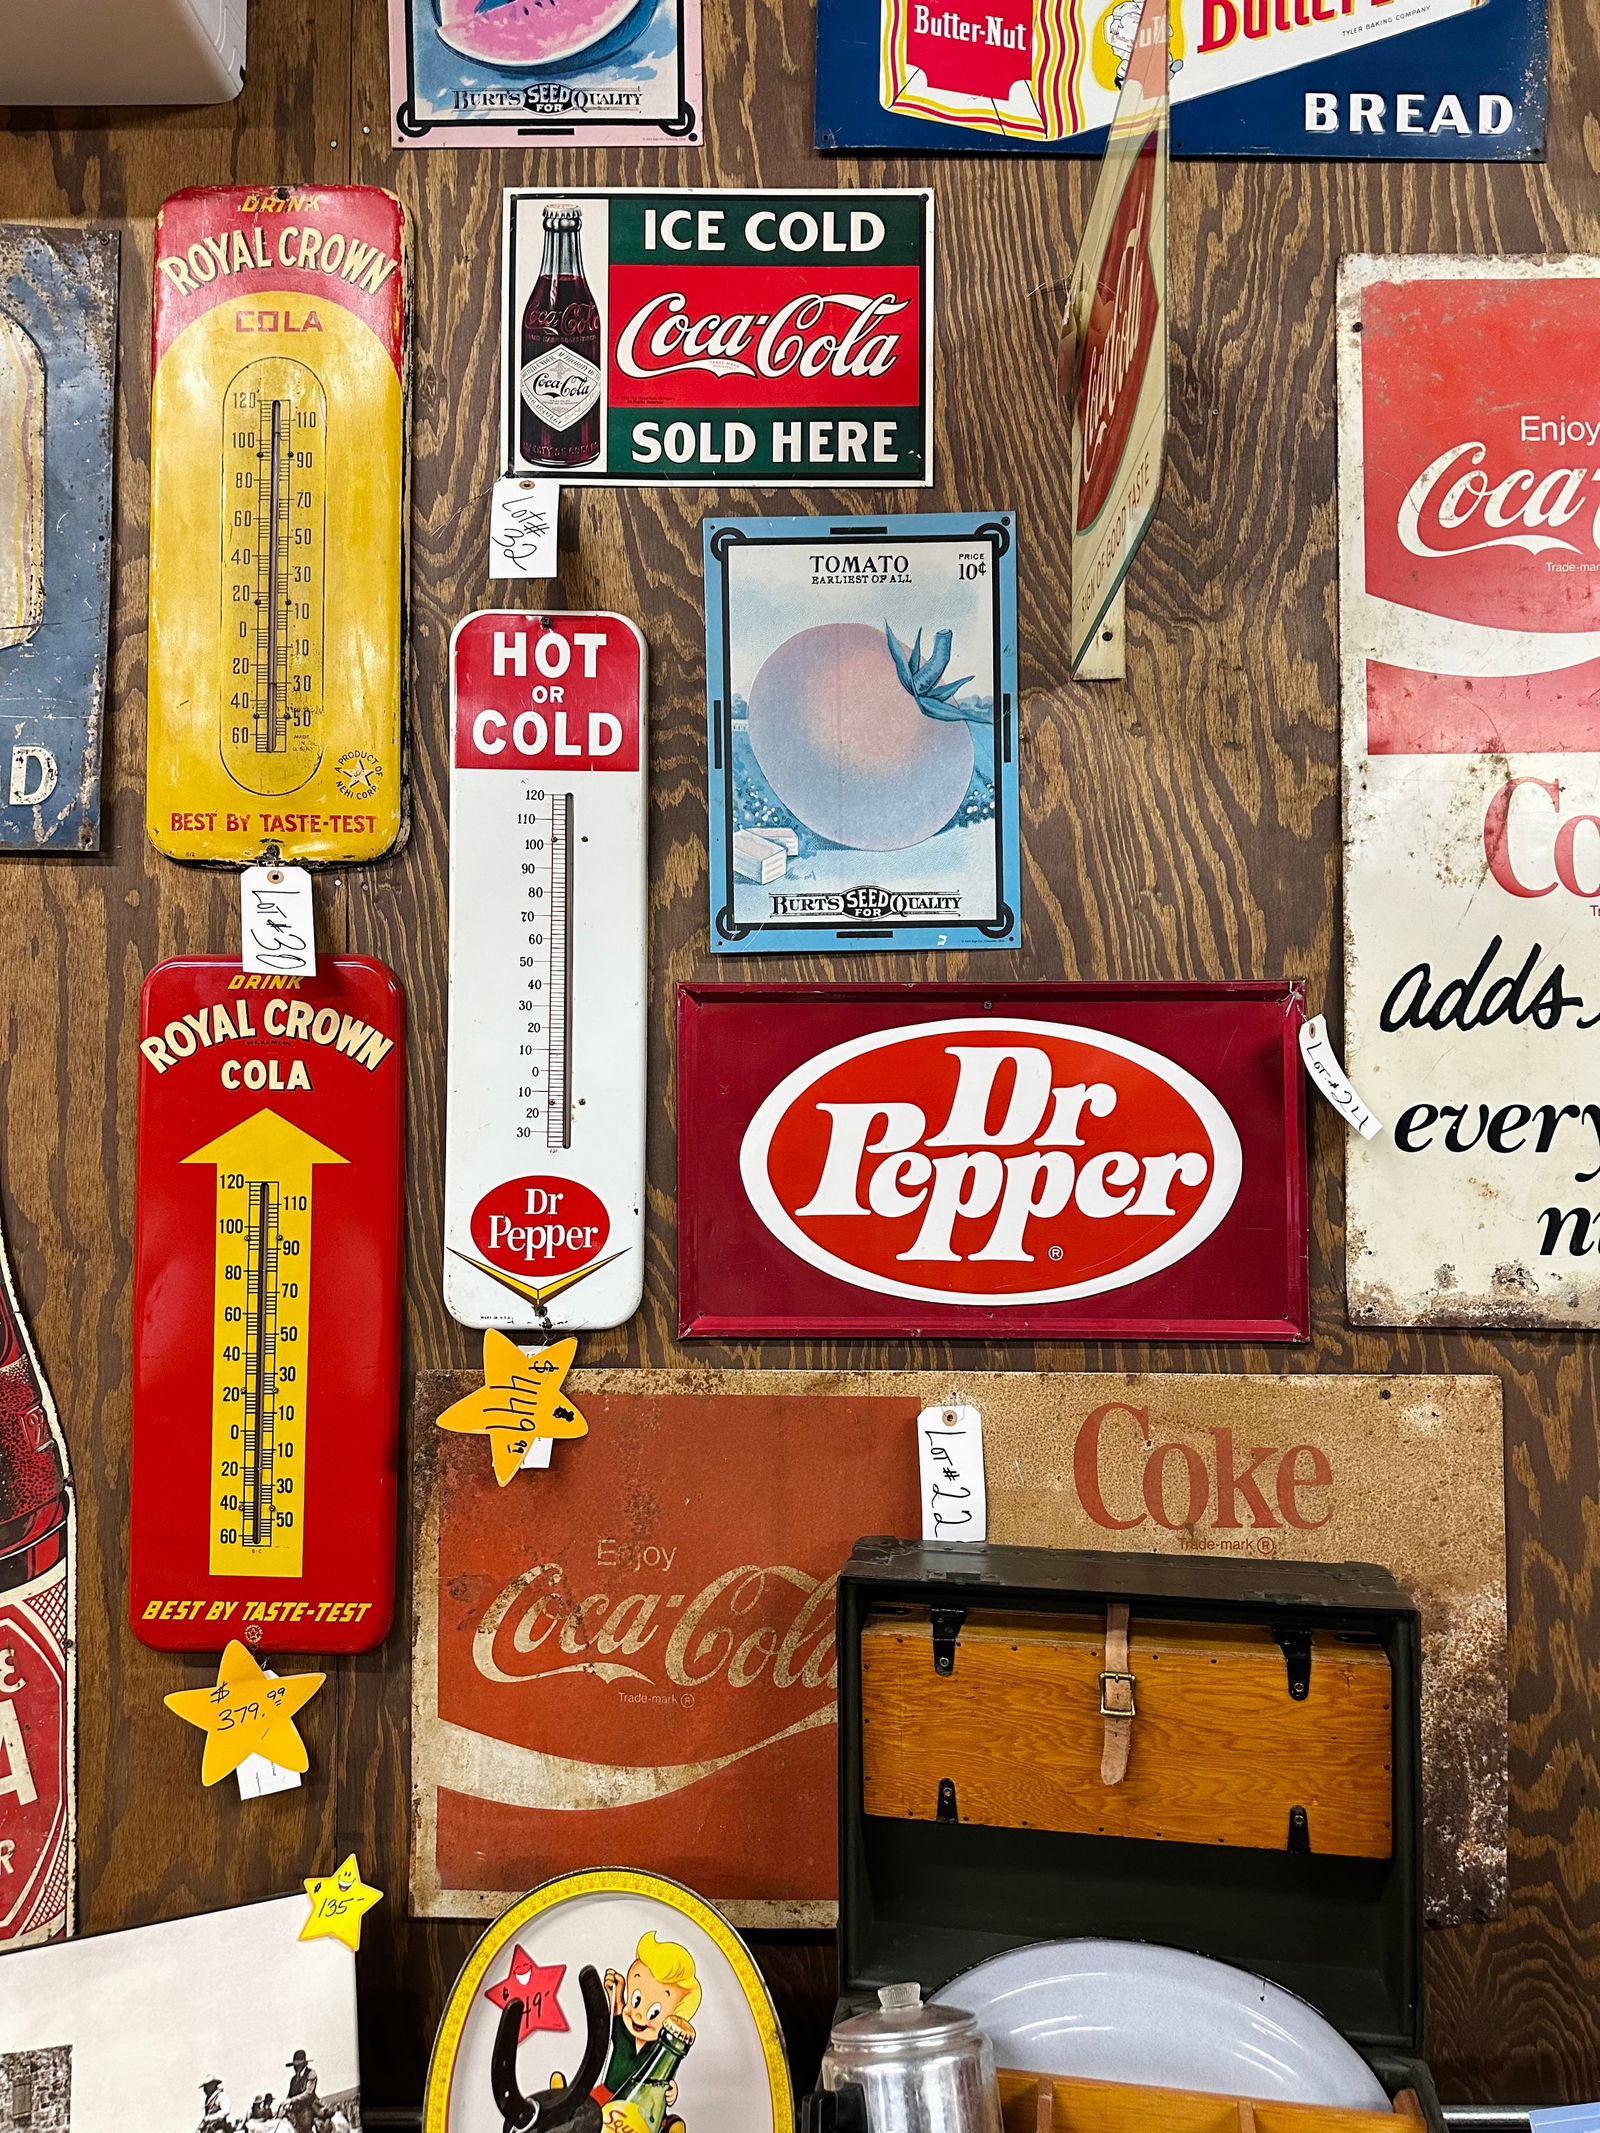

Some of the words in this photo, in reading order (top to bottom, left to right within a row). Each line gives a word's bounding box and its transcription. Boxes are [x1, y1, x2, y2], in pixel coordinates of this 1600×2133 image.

[914, 4, 1027, 51] Butter-Nut
[1342, 25, 1363, 37] TYLER
[1366, 17, 1393, 30] BAKING
[1395, 4, 1431, 21] COMPANY
[453, 89, 523, 110] BURT'S
[526, 85, 568, 104] SEED
[571, 89, 643, 113] QUALITY
[536, 103, 562, 112] FOR
[1303, 92, 1513, 137] BREAD
[241, 195, 320, 213] DRINK
[644, 209, 725, 252] ICE
[744, 210, 886, 252] COLD
[159, 227, 274, 296] ROYAL
[278, 226, 398, 296] CROWN
[235, 310, 323, 333] COLA
[616, 292, 913, 379] Coca-Cola
[533, 373, 590, 398] Coca-Cola
[233, 392, 256, 409] 120
[297, 412, 316, 428] 110
[1521, 415, 1600, 446] Enjoy
[232, 432, 255, 448] 100
[631, 421, 757, 464] SOLD
[771, 421, 899, 464] HERE
[297, 452, 313, 468] 90
[235, 472, 253, 488] 80
[296, 492, 312, 508] 70
[234, 510, 252, 527] 60
[294, 528, 312, 545] 50
[1081, 584, 1096, 623] SIGN
[1106, 505, 1127, 569] GOOD
[1127, 451, 1150, 522] TASTE
[231, 548, 250, 565] 40
[492, 528, 538, 571] 32
[809, 555, 909, 573] TOMATO
[958, 561, 986, 581] 10¢
[294, 566, 311, 582] 30
[812, 575, 868, 585] EARLIEST
[871, 575, 888, 584] OF
[890, 574, 912, 584] ALL
[232, 585, 250, 601] 20
[294, 603, 309, 619] 10
[239, 621, 247, 637] 0
[294, 640, 309, 656] 10
[493, 631, 607, 679] HOT
[232, 657, 249, 674] 20
[293, 675, 311, 692] 30
[230, 692, 249, 708] 40
[532, 685, 565, 704] OR
[293, 710, 311, 727] 50
[232, 727, 249, 743] 60
[472, 709, 623, 756] COLD
[338, 750, 379, 766] PRODUCT
[374, 766, 384, 777] OF
[336, 780, 354, 799] NEHI
[525, 790, 545, 801] 120
[171, 813, 217, 832] BEST
[227, 813, 250, 832] BY
[259, 814, 376, 833] TASTE-TEST
[517, 814, 536, 824] 110
[525, 839, 544, 850] 100
[521, 863, 535, 874] 90
[528, 887, 543, 898] 80
[847, 888, 888, 909] SEED
[772, 895, 840, 915] BURT'S
[855, 908, 882, 917] FOR
[890, 895, 962, 917] QUALITY
[520, 911, 535, 922] 70
[528, 934, 543, 945] 60
[519, 957, 534, 967] 50
[228, 974, 304, 990] DRINK
[527, 979, 542, 990] 40
[1379, 934, 1584, 1033] adds
[518, 1000, 533, 1010] 30
[527, 1022, 541, 1033] 20
[140, 999, 257, 1075] ROYAL
[263, 998, 394, 1072] CROWN
[519, 1045, 532, 1055] 10
[221, 1059, 312, 1091] COLA
[532, 1067, 539, 1077] 0
[518, 1087, 531, 1097] 10
[925, 1046, 1117, 1147] Dr
[526, 1108, 539, 1118] 20
[516, 1127, 531, 1138] 30
[219, 1174, 244, 1189] 120
[794, 1102, 1208, 1261] Pepper
[283, 1196, 307, 1211] 110
[525, 1188, 564, 1215] Dr
[219, 1219, 243, 1234] 100
[488, 1215, 599, 1261] Pepper
[282, 1240, 300, 1256] 90
[224, 1265, 242, 1281] 80
[281, 1283, 298, 1299] 70
[224, 1306, 242, 1322] 60
[280, 1326, 298, 1342] 50
[223, 1346, 241, 1361] 40
[279, 1366, 296, 1382] 30
[222, 1387, 240, 1402] 20
[279, 1406, 295, 1421] 10
[230, 1424, 239, 1440] 0
[278, 1442, 294, 1458] 10
[221, 1461, 238, 1476] 20
[1073, 1401, 1334, 1531] Coke
[276, 1478, 293, 1493] 30
[220, 1495, 238, 1510] 40
[276, 1512, 293, 1527] 50
[220, 1528, 237, 1544] 60
[1177, 1537, 1253, 1550] Trade-mark
[142, 1600, 206, 1620] BEST
[205, 1601, 239, 1620] BY
[242, 1602, 372, 1622] TASTE-TEST
[617, 1692, 678, 1706] Trade-mark
